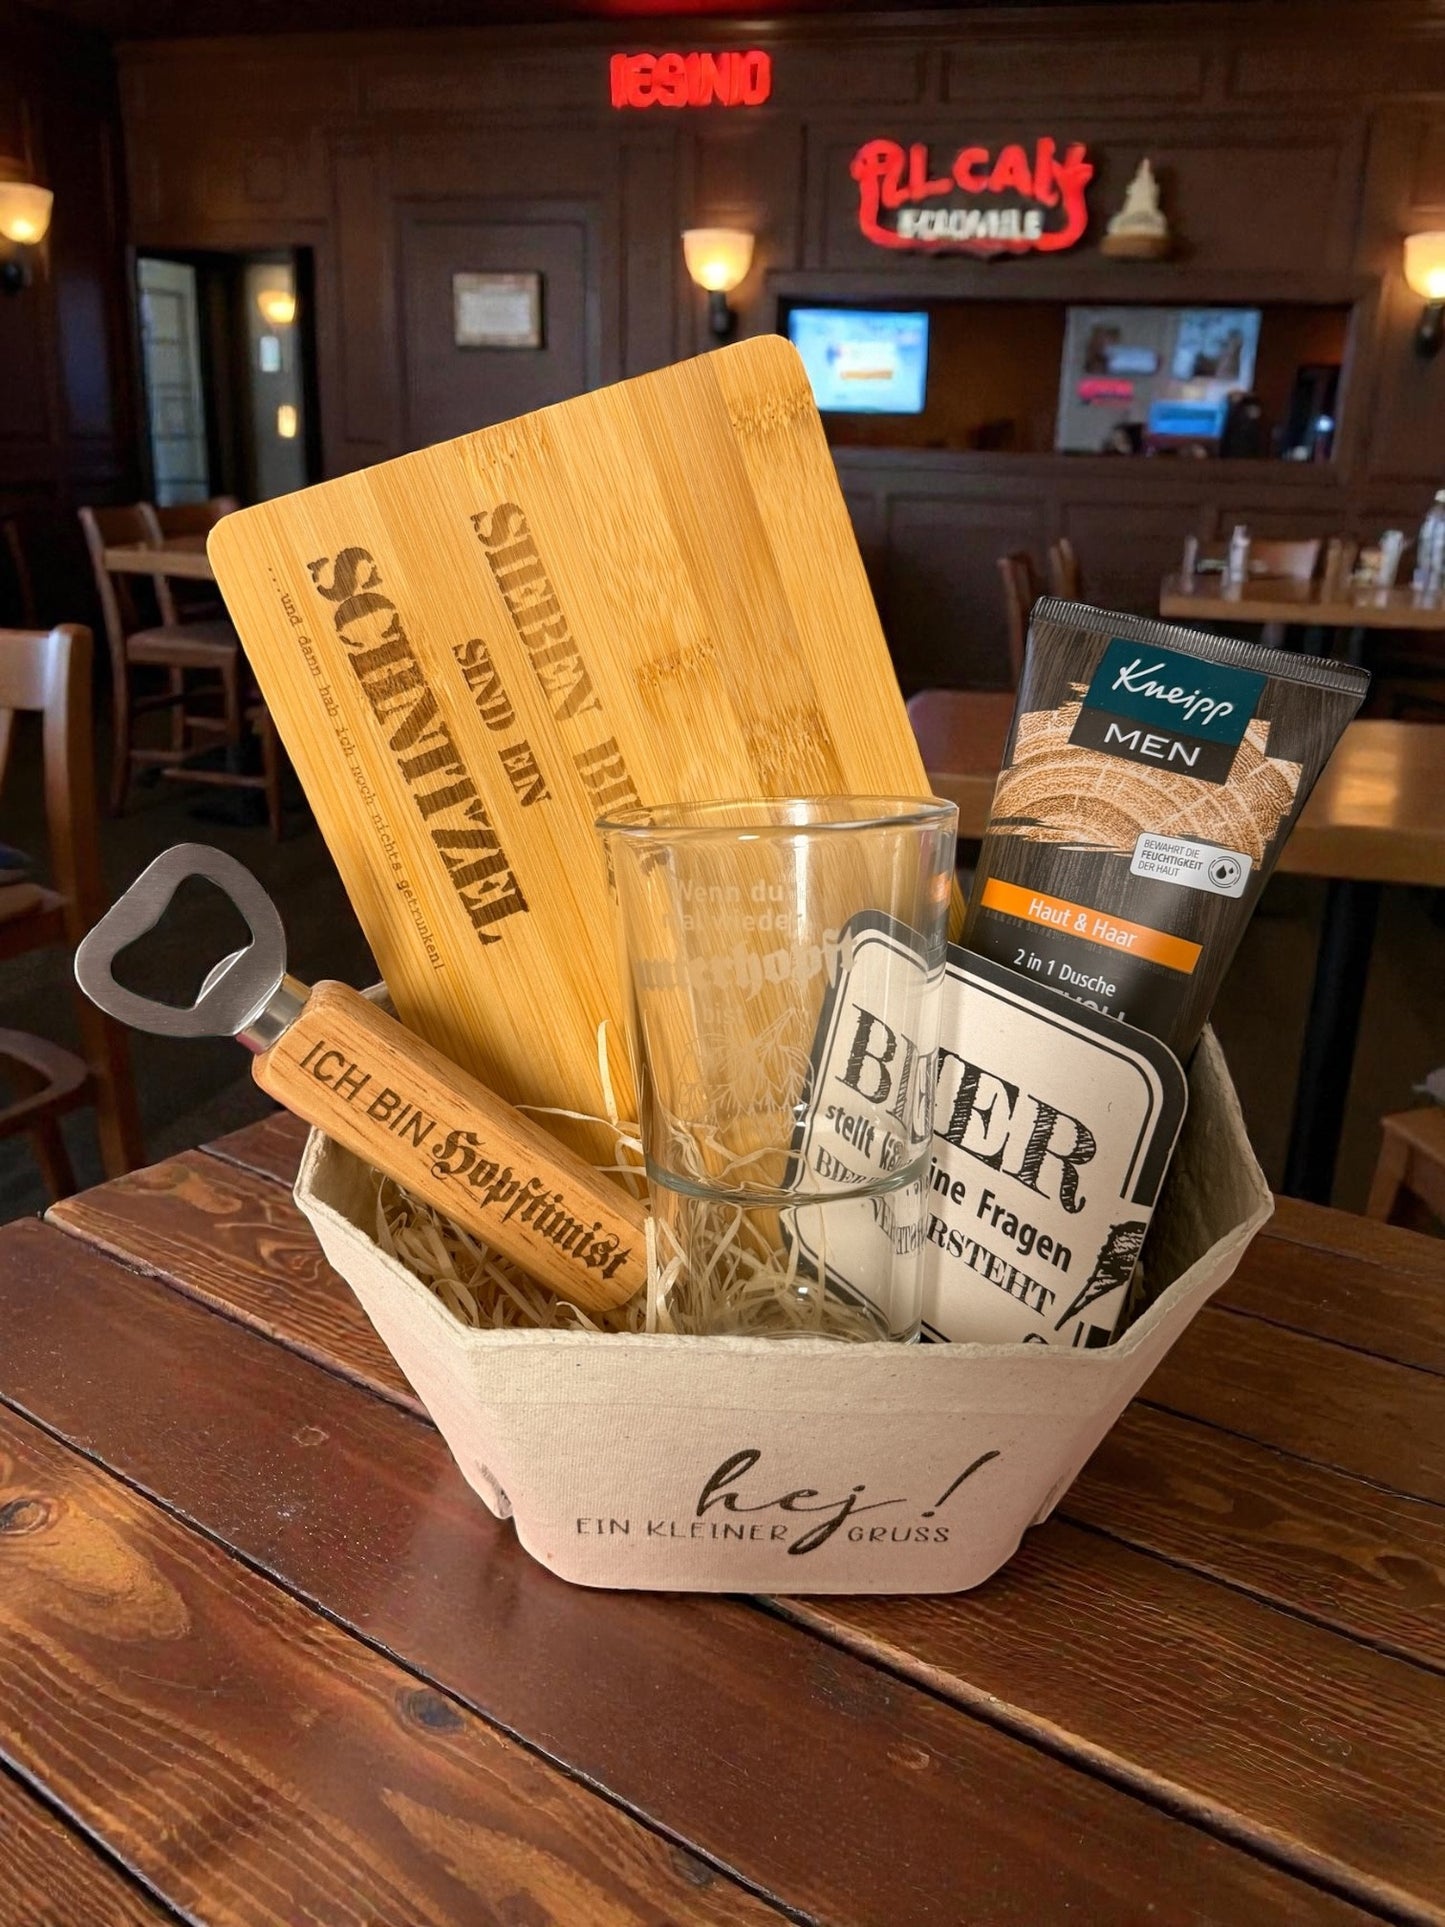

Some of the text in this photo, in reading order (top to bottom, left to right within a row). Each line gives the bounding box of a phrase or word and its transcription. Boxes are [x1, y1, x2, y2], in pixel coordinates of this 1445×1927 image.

[470, 502, 603, 723] SIEBEN
[1112, 658, 1234, 725] Kneipp
[306, 545, 530, 946] SCHNITZEL
[451, 637, 552, 808] SIND EIN
[1103, 722, 1201, 767] MEN
[298, 634, 322, 678] dann
[319, 684, 340, 718] hab
[335, 727, 355, 758] ich
[352, 765, 375, 807] noch
[371, 811, 402, 872] nichts
[396, 878, 446, 971] getrunken!
[1138, 860, 1180, 877] DER HAUT
[1141, 850, 1203, 871] FEUCHTIGKEIT
[1144, 839, 1201, 859] BEWAHRT DIE
[751, 879, 784, 901] du
[1028, 897, 1138, 948] Haut & Haar
[1013, 948, 1116, 998] 2 in 1 Dusche
[299, 1040, 372, 1101] ICH
[365, 1087, 436, 1148] BIN
[835, 1003, 1097, 1214] BIER
[824, 1104, 875, 1159] stellt
[975, 1189, 1073, 1272] Fragen
[575, 1516, 950, 1543] EIN KLEINER GRUSS
